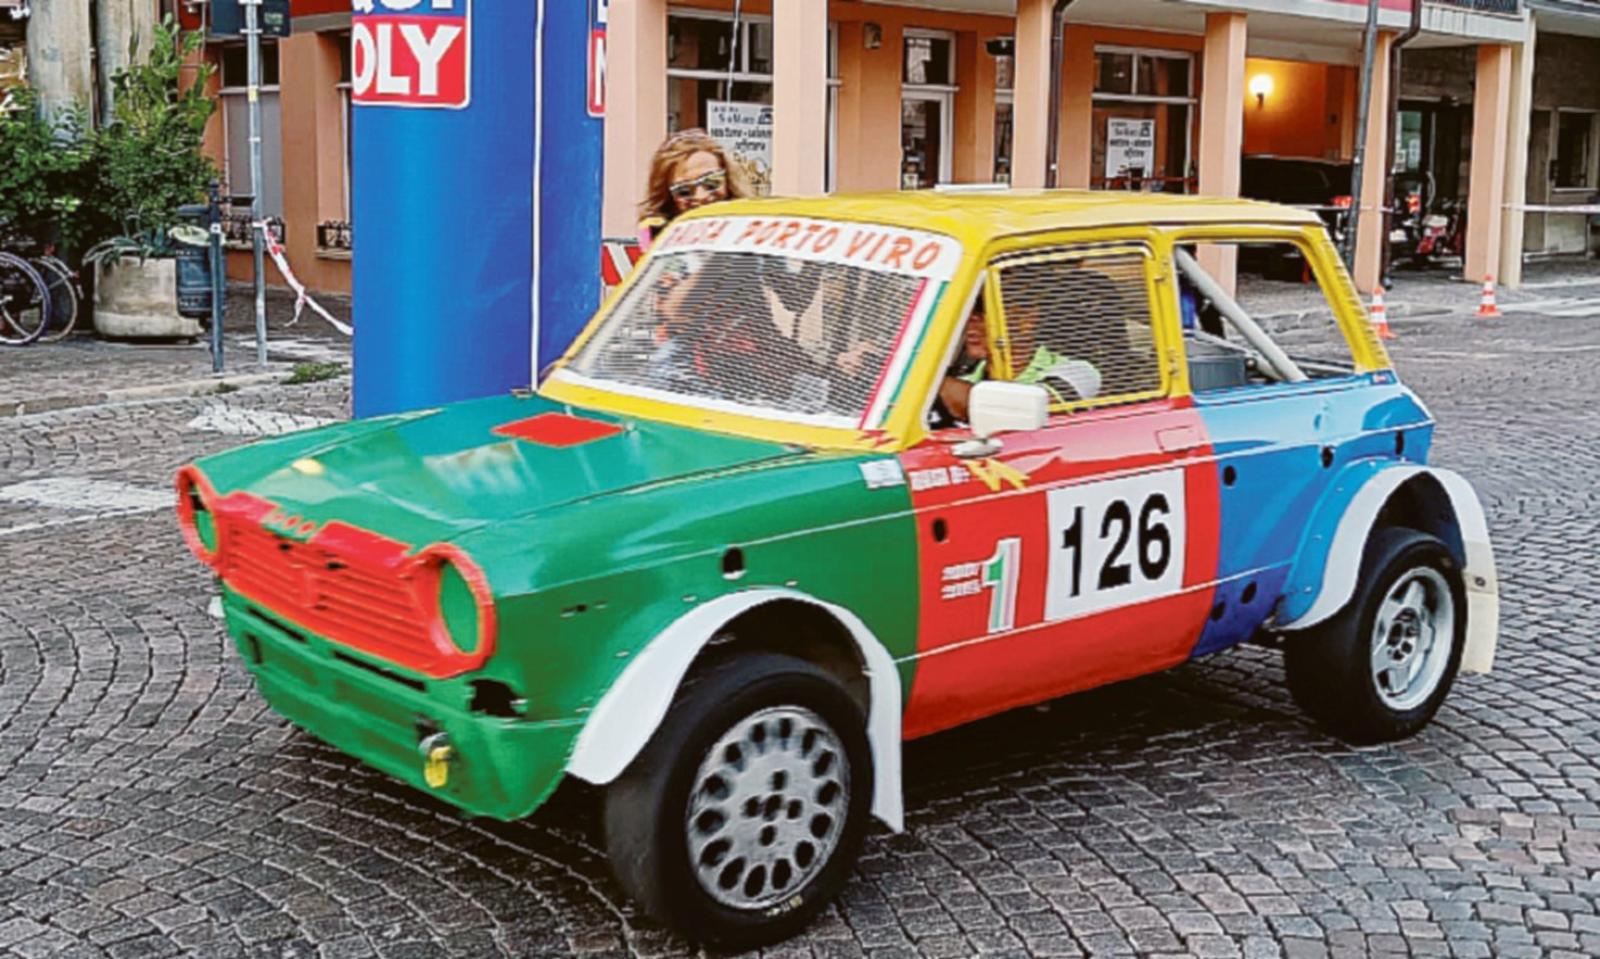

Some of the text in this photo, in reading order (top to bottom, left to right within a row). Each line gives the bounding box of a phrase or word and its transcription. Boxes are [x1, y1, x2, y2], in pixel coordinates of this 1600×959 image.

[734, 220, 840, 254] PORTO
[844, 229, 942, 271] VIRO
[1061, 492, 1171, 598] 126
